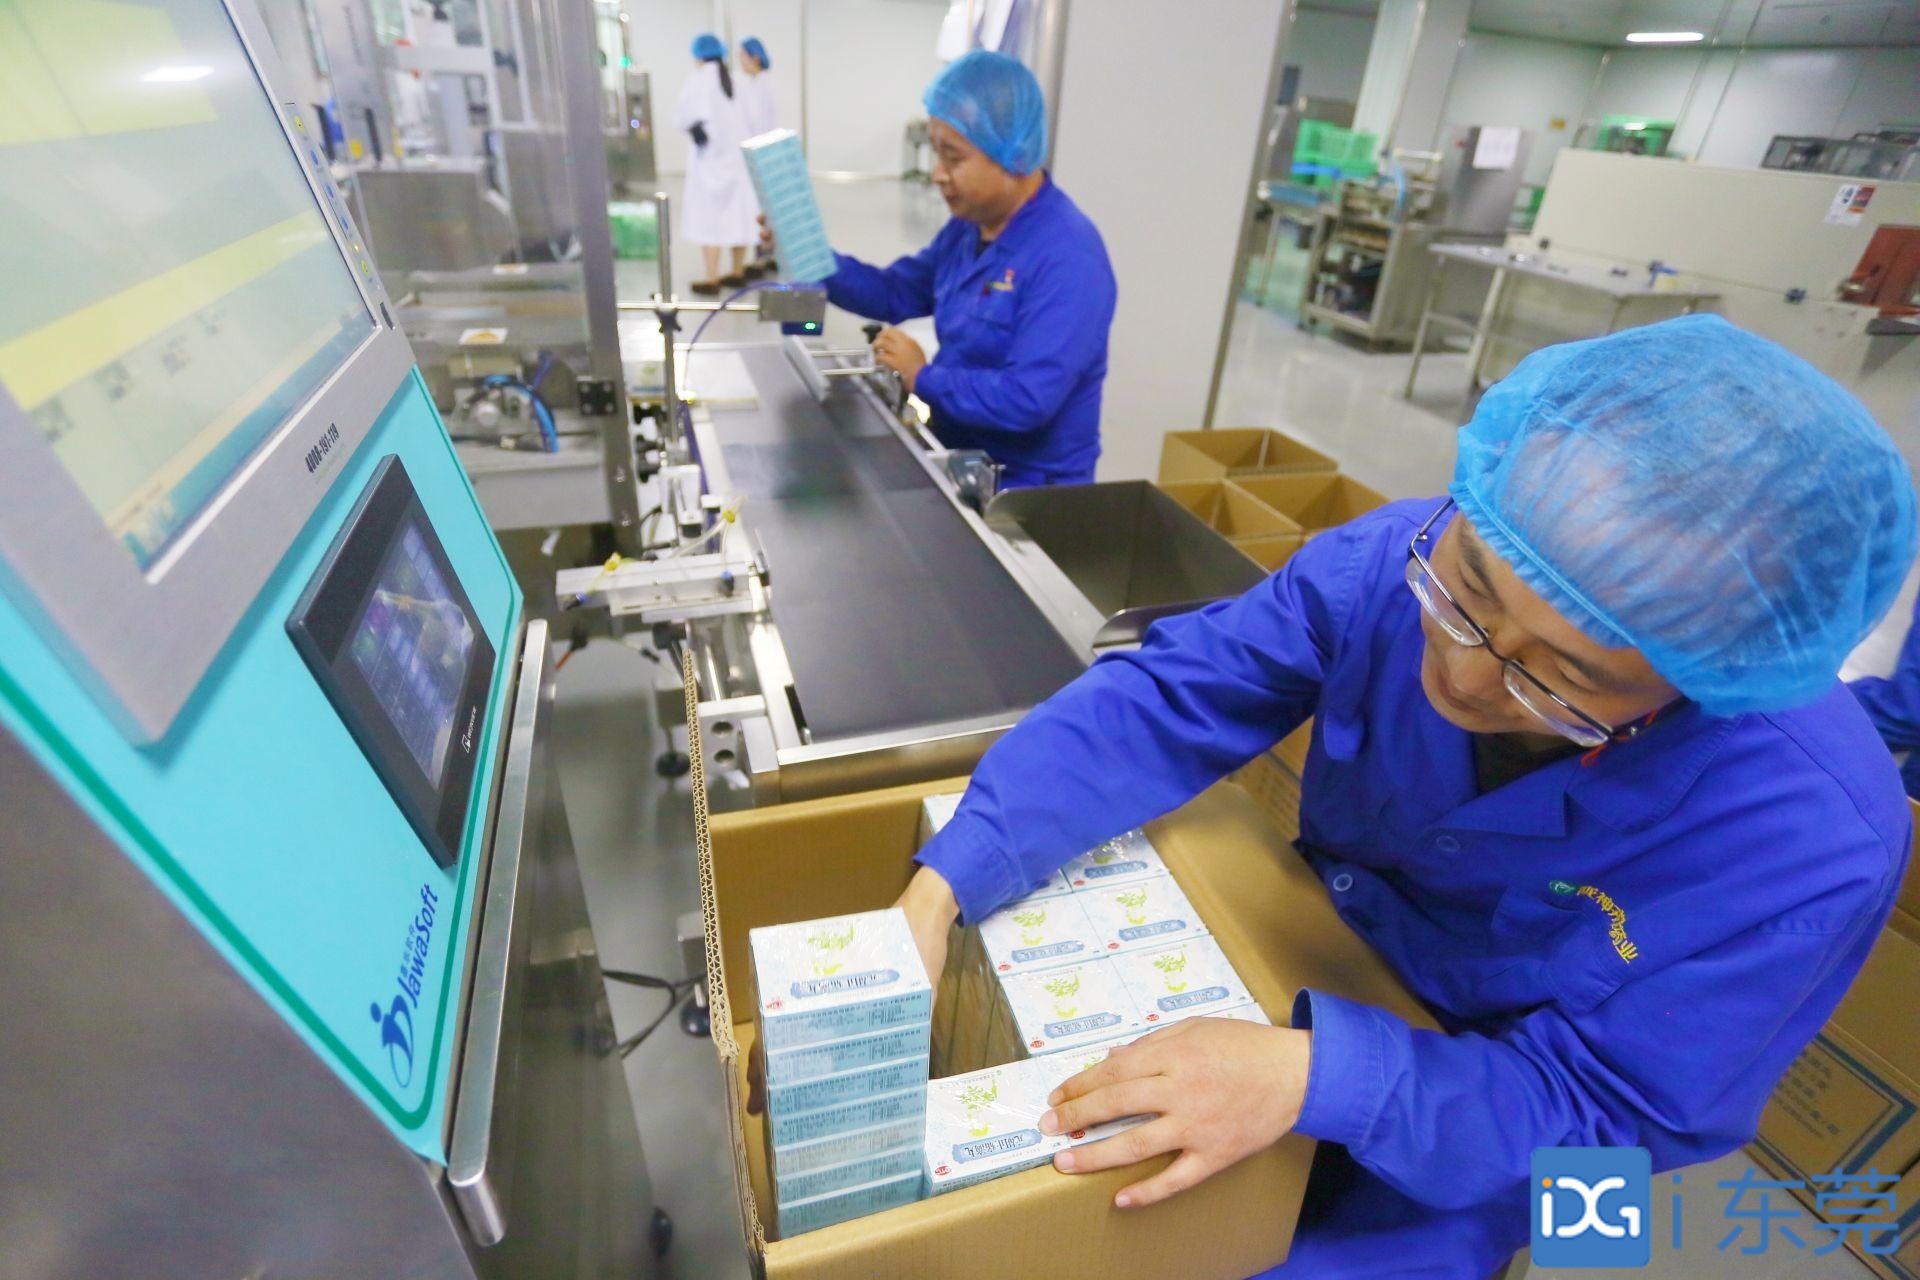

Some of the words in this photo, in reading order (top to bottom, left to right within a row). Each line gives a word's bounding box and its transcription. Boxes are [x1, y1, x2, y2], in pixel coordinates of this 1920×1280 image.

[397, 883, 438, 1008] JawaSoft
[963, 1135, 1025, 1158] 元胡止痛滴丸
